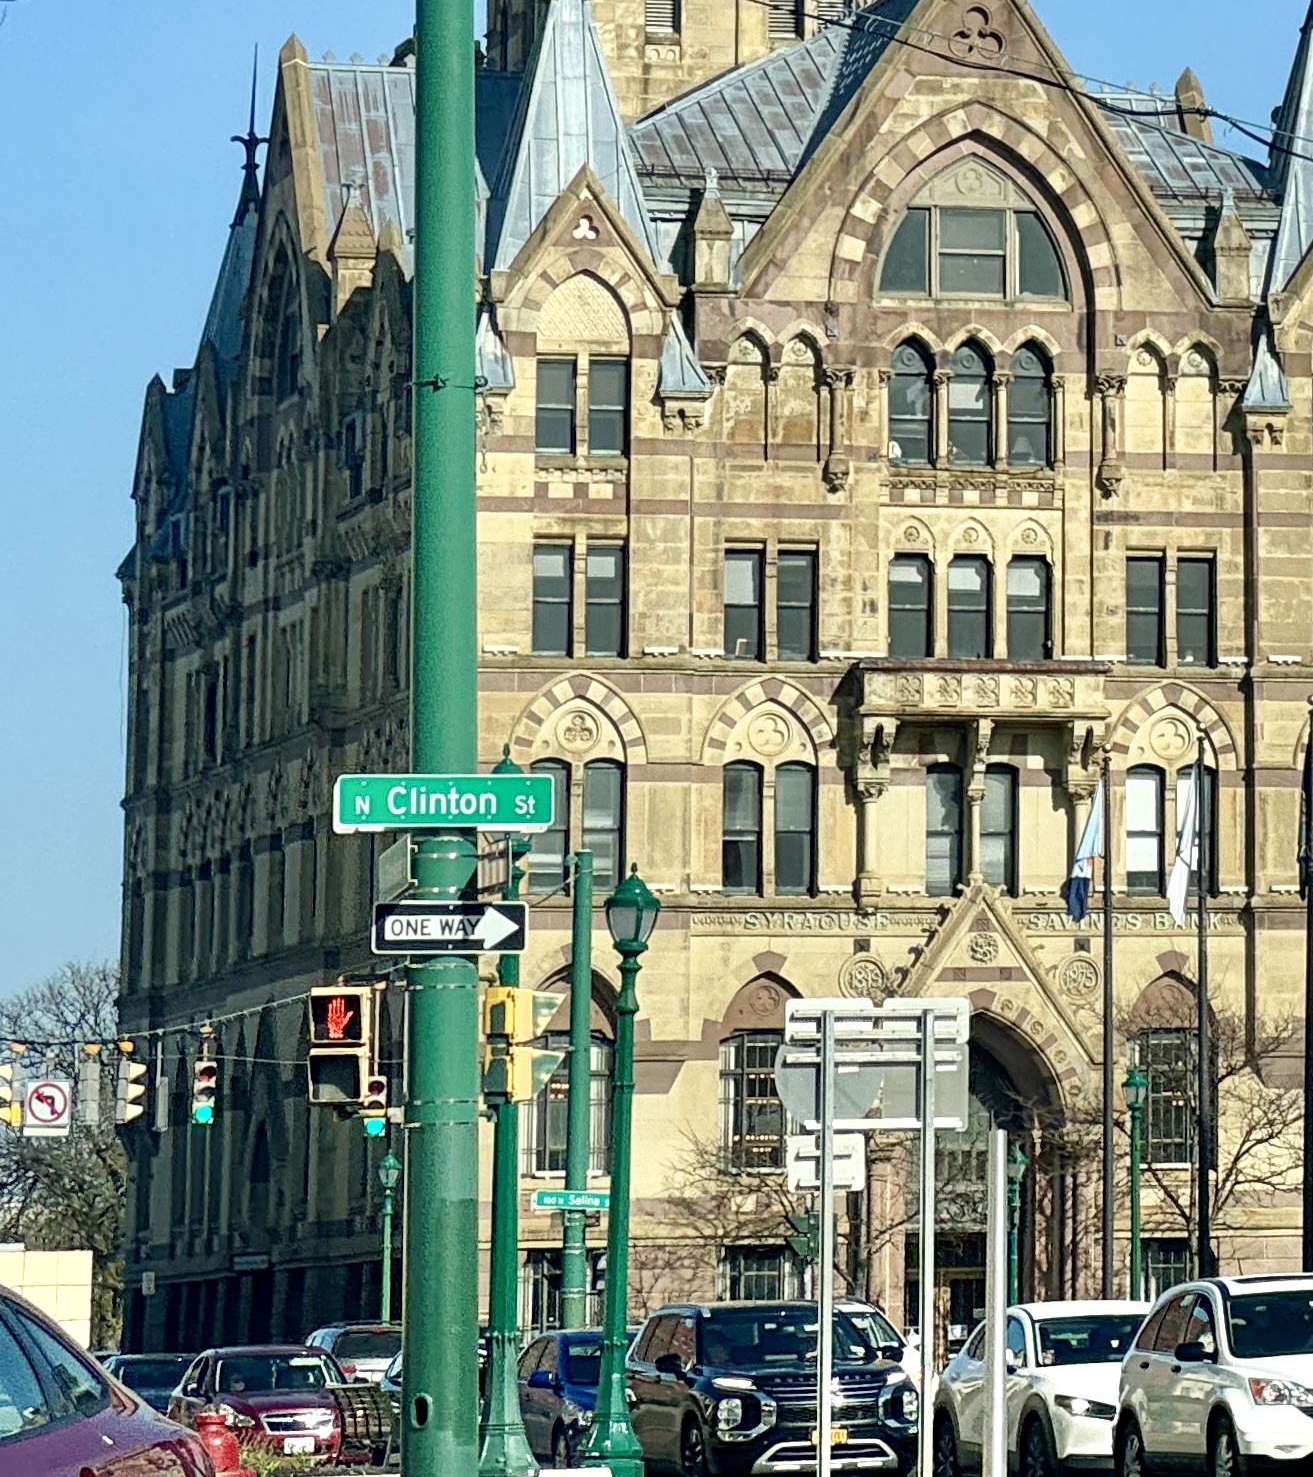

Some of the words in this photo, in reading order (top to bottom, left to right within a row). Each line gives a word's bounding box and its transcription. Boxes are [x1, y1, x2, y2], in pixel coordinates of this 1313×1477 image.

[355, 795, 370, 815] N
[387, 786, 497, 815] Clinton
[514, 795, 536, 815] St
[391, 918, 431, 937] ONE
[439, 918, 480, 936] WAY
[1065, 969, 1096, 989] 1875
[568, 1194, 600, 1207] Salina
